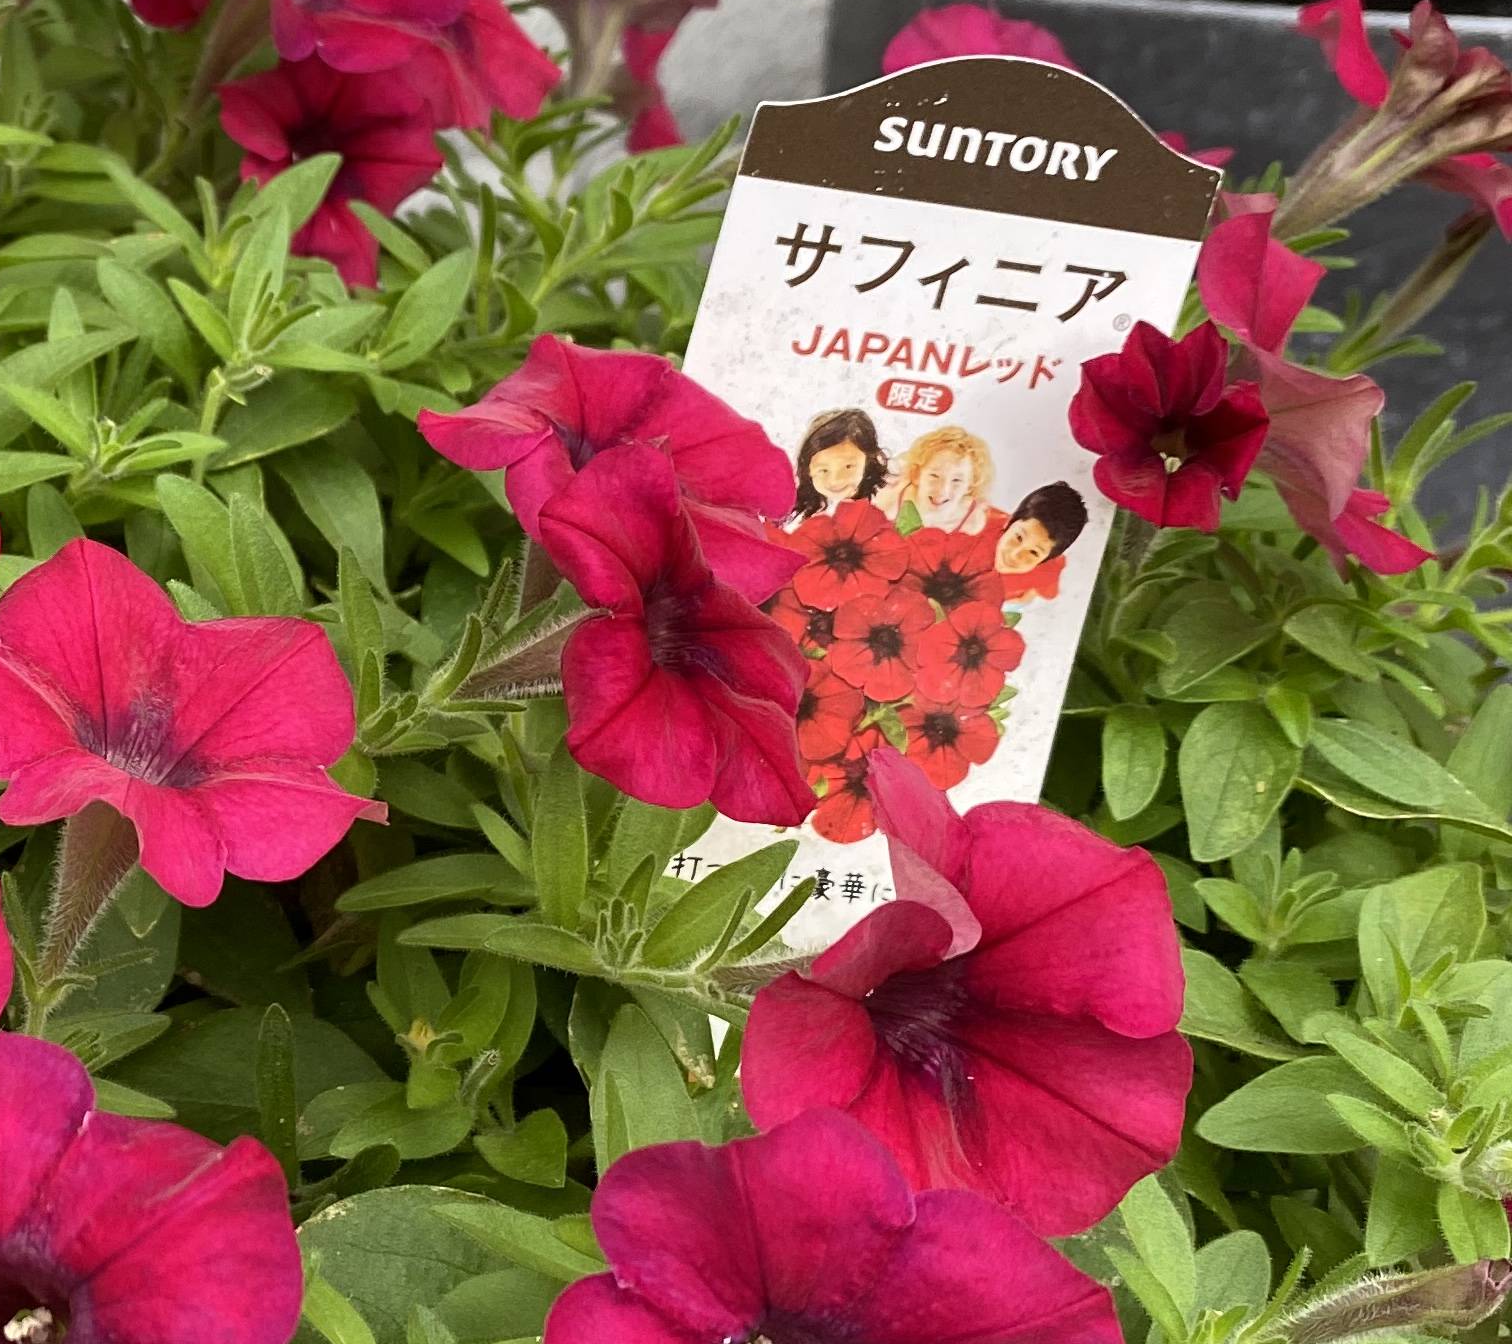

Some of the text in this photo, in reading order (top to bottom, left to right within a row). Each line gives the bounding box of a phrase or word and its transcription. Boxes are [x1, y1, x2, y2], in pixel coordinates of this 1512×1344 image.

[873, 116, 1118, 182] SUNTORY
[791, 324, 1064, 389] JAPANレッド
[885, 382, 944, 412] 限定
